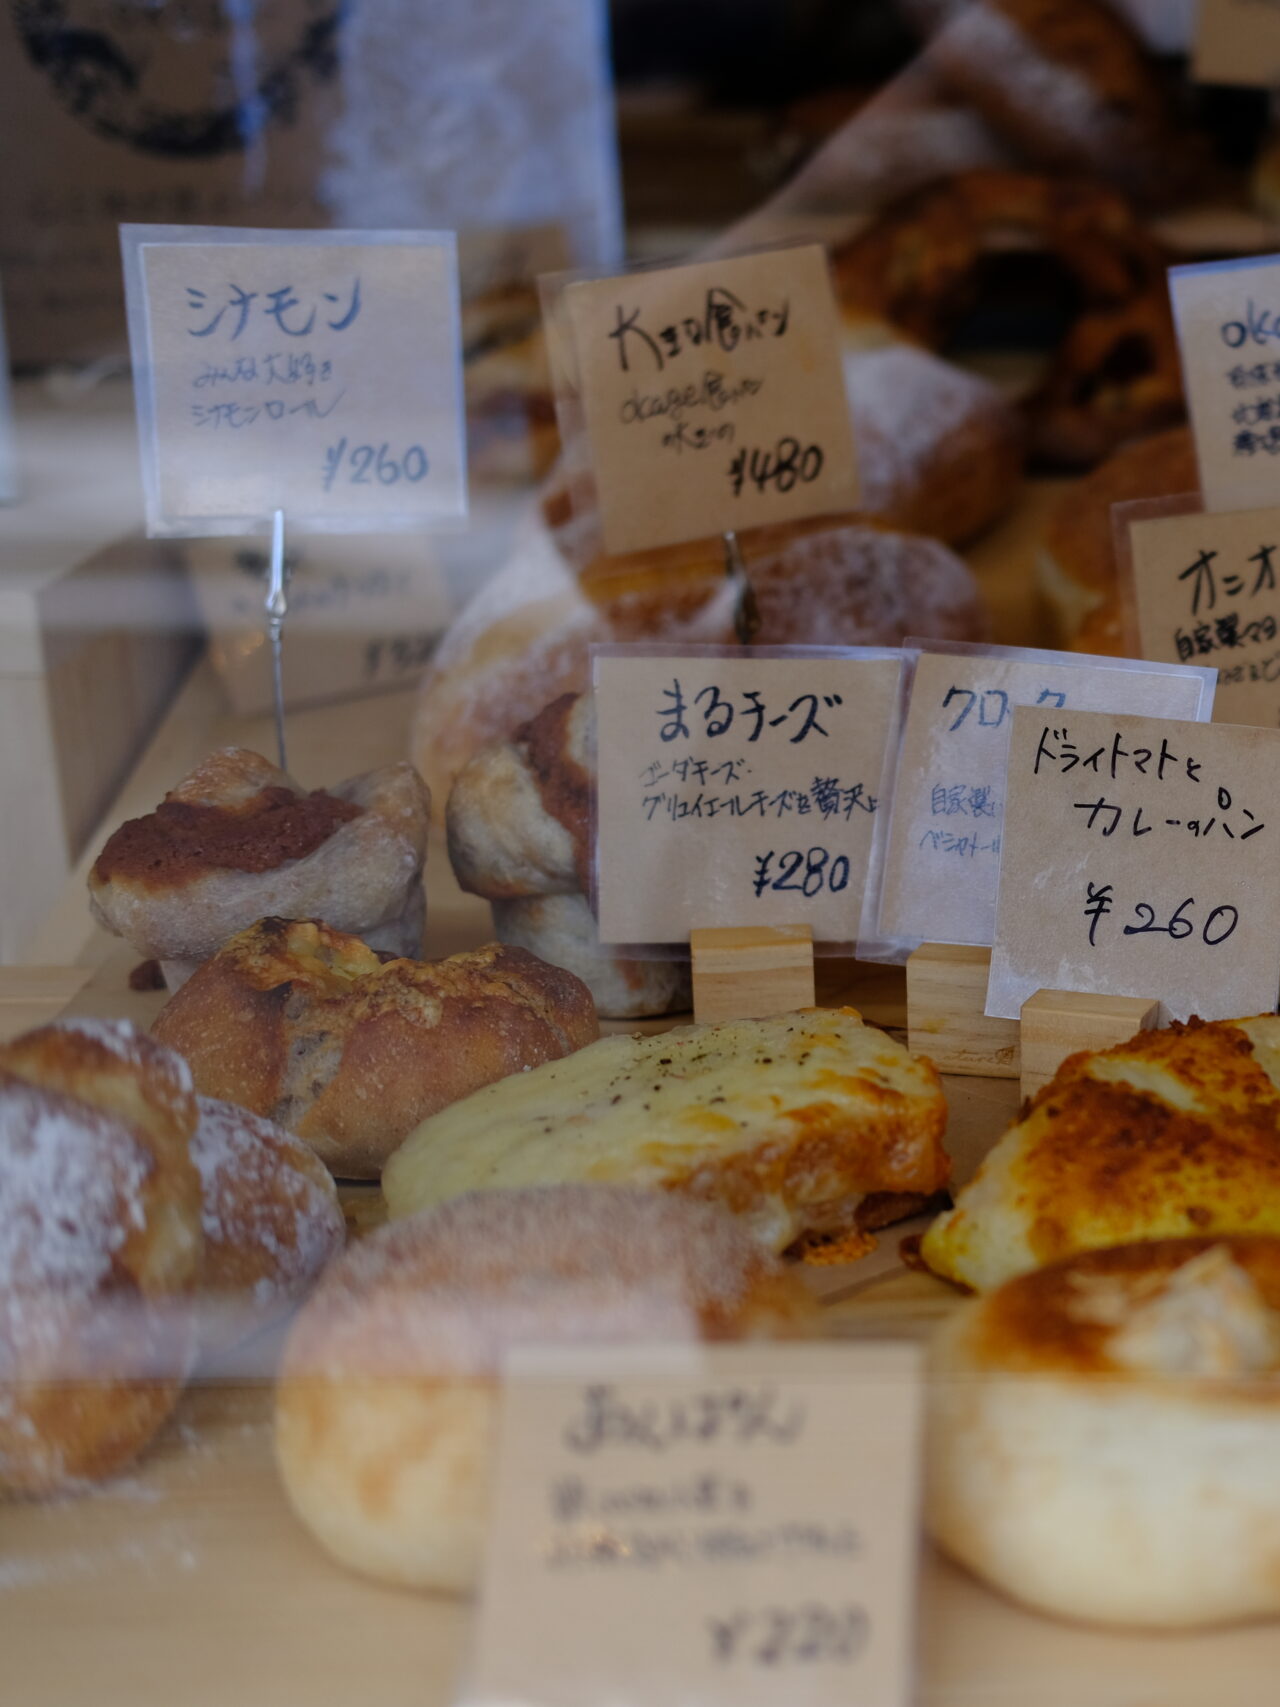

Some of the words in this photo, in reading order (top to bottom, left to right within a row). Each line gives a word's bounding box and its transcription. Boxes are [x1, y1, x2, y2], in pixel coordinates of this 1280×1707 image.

[186, 276, 361, 340] シナモン
[322, 437, 429, 493] ¥260
[728, 436, 825, 497] ¥480
[656, 678, 843, 744] まるチーズ
[1034, 727, 1201, 781] ドライトマトと
[932, 783, 1001, 818] 自家製
[1074, 787, 1265, 839] カレーのパン
[752, 846, 850, 897] ¥280
[1083, 882, 1239, 947] ¥260
